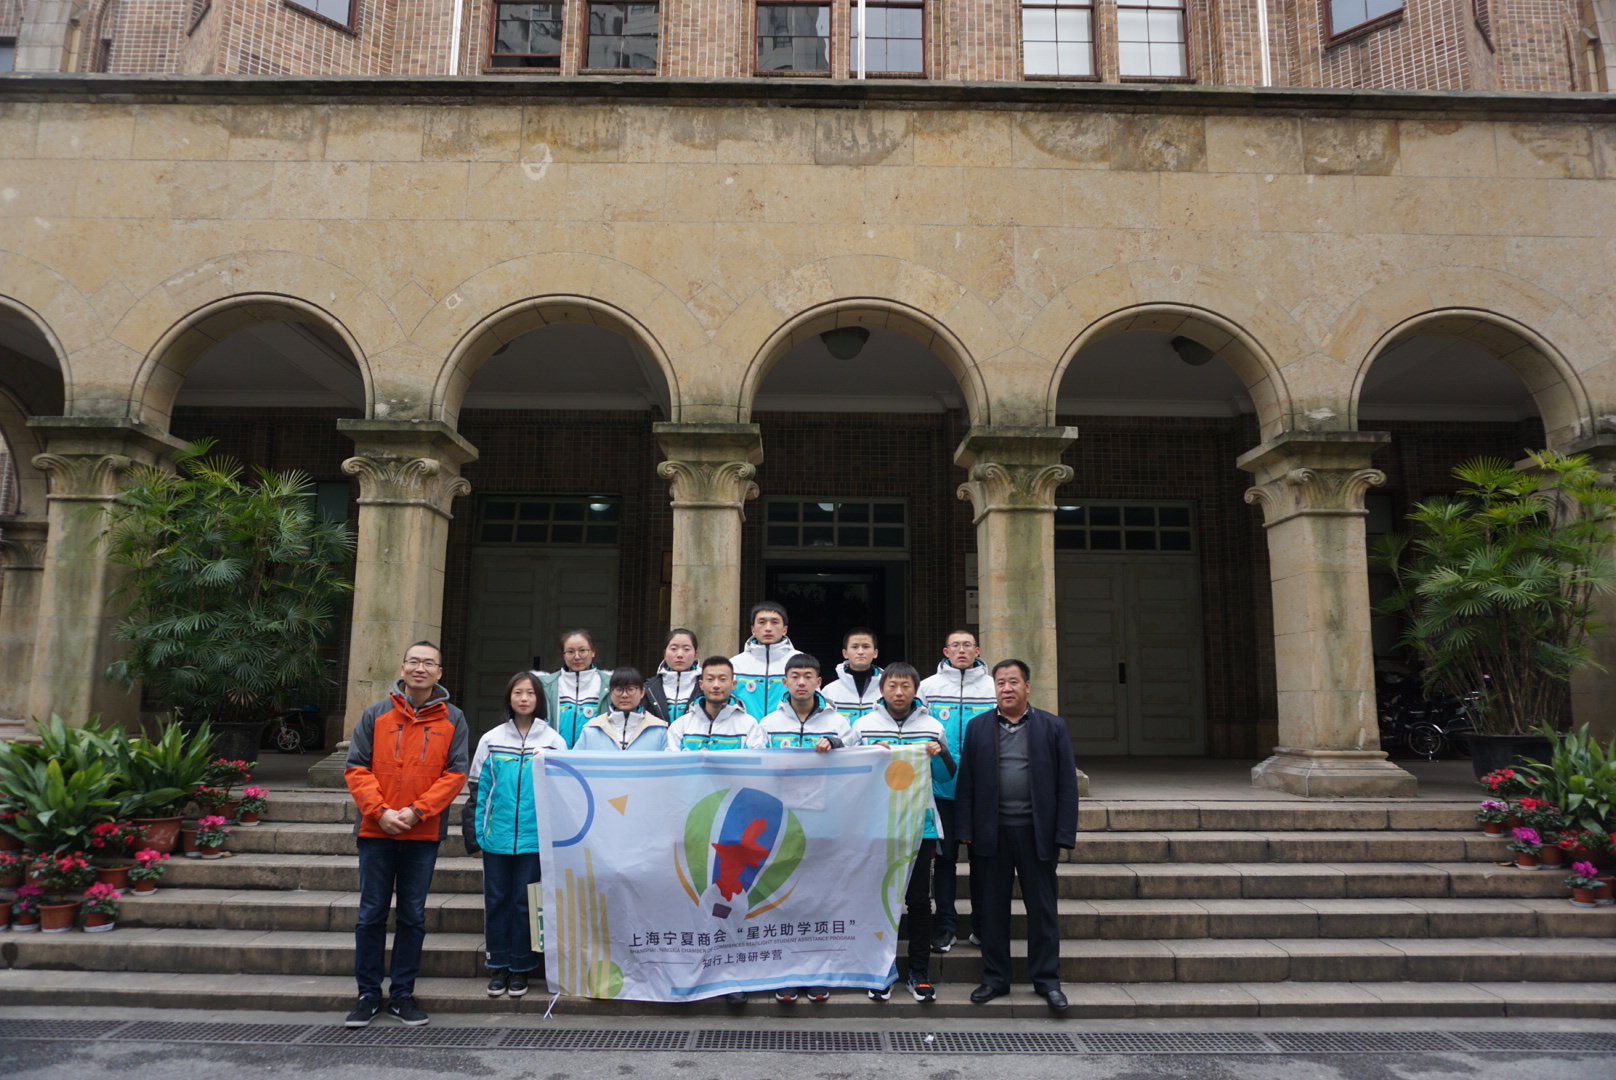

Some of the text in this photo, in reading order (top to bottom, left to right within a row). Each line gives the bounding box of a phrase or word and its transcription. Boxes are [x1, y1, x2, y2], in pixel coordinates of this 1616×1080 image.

[702, 949, 782, 969] 知行上海研学营
